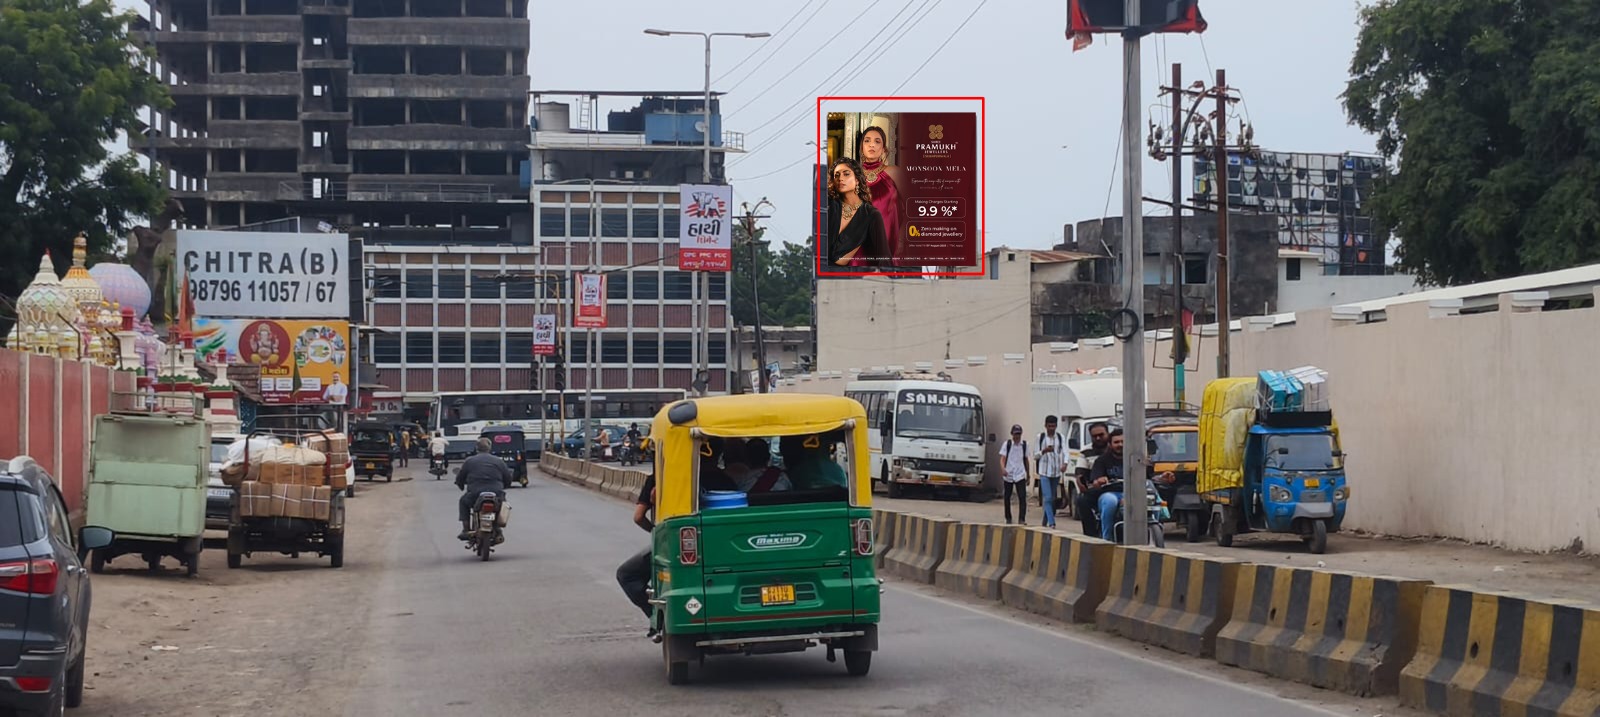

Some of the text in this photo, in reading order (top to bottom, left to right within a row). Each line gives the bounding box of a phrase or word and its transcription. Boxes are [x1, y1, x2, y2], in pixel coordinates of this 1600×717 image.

[918, 205, 938, 217] 9.9
[688, 219, 721, 237] હાથી
[908, 225, 921, 237] 0%
[247, 280, 300, 303] 11057
[316, 281, 337, 303] 67
[906, 392, 975, 408] SANJARI
